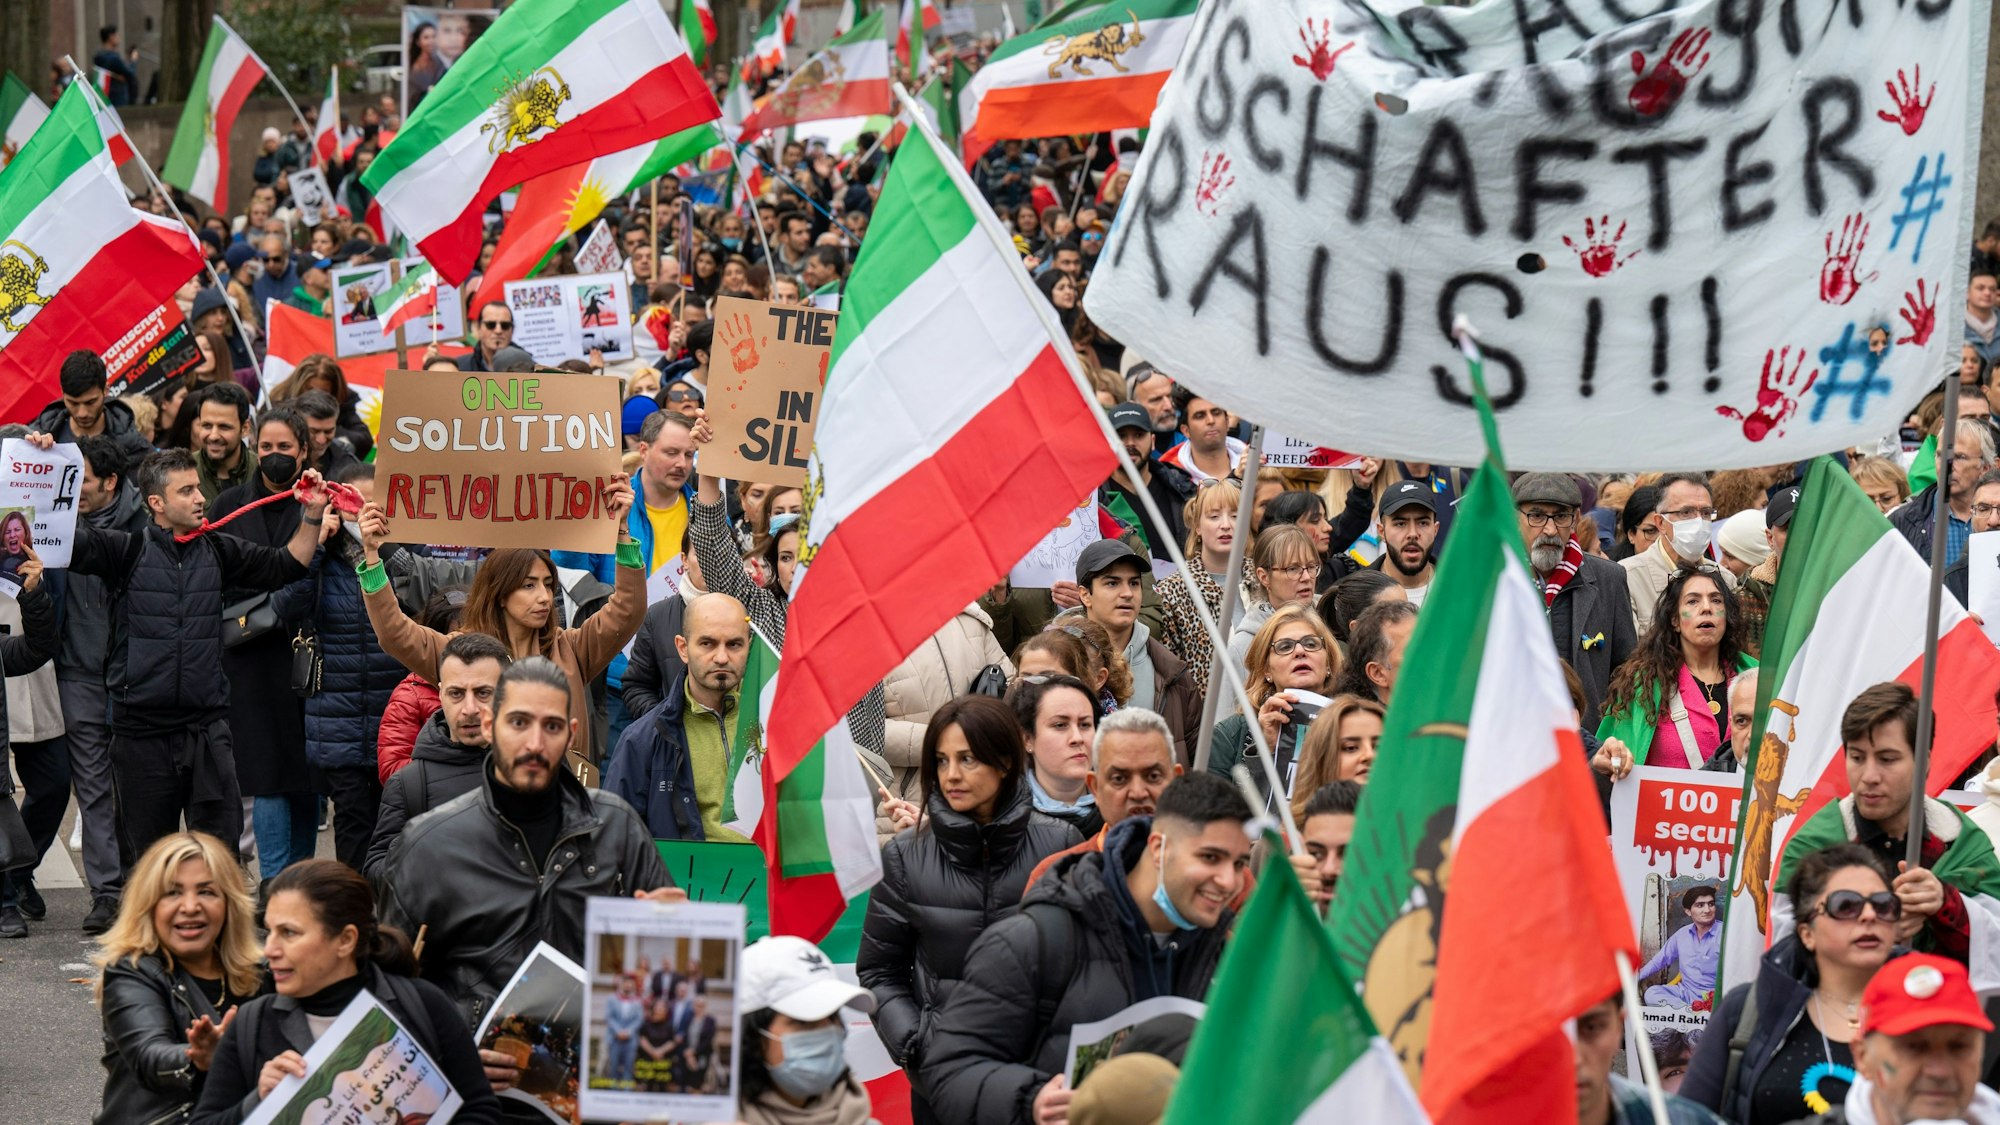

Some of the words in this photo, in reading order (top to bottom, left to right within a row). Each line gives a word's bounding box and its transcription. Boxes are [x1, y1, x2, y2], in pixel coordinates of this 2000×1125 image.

[768, 307, 838, 346] THE
[125, 324, 189, 384] Kurdistan!
[462, 376, 543, 411] ONE
[776, 390, 814, 423] IN
[388, 411, 616, 453] SOLUTION
[738, 417, 809, 469] SIL
[12, 461, 54, 475] STOP
[1266, 453, 1329, 465] FREEDOM
[10, 481, 53, 489] EXECUTION
[386, 472, 618, 523] REVOLUTION
[32, 536, 62, 547] adeh
[1659, 788, 1719, 815] 100
[342, 1080, 364, 1102] Life
